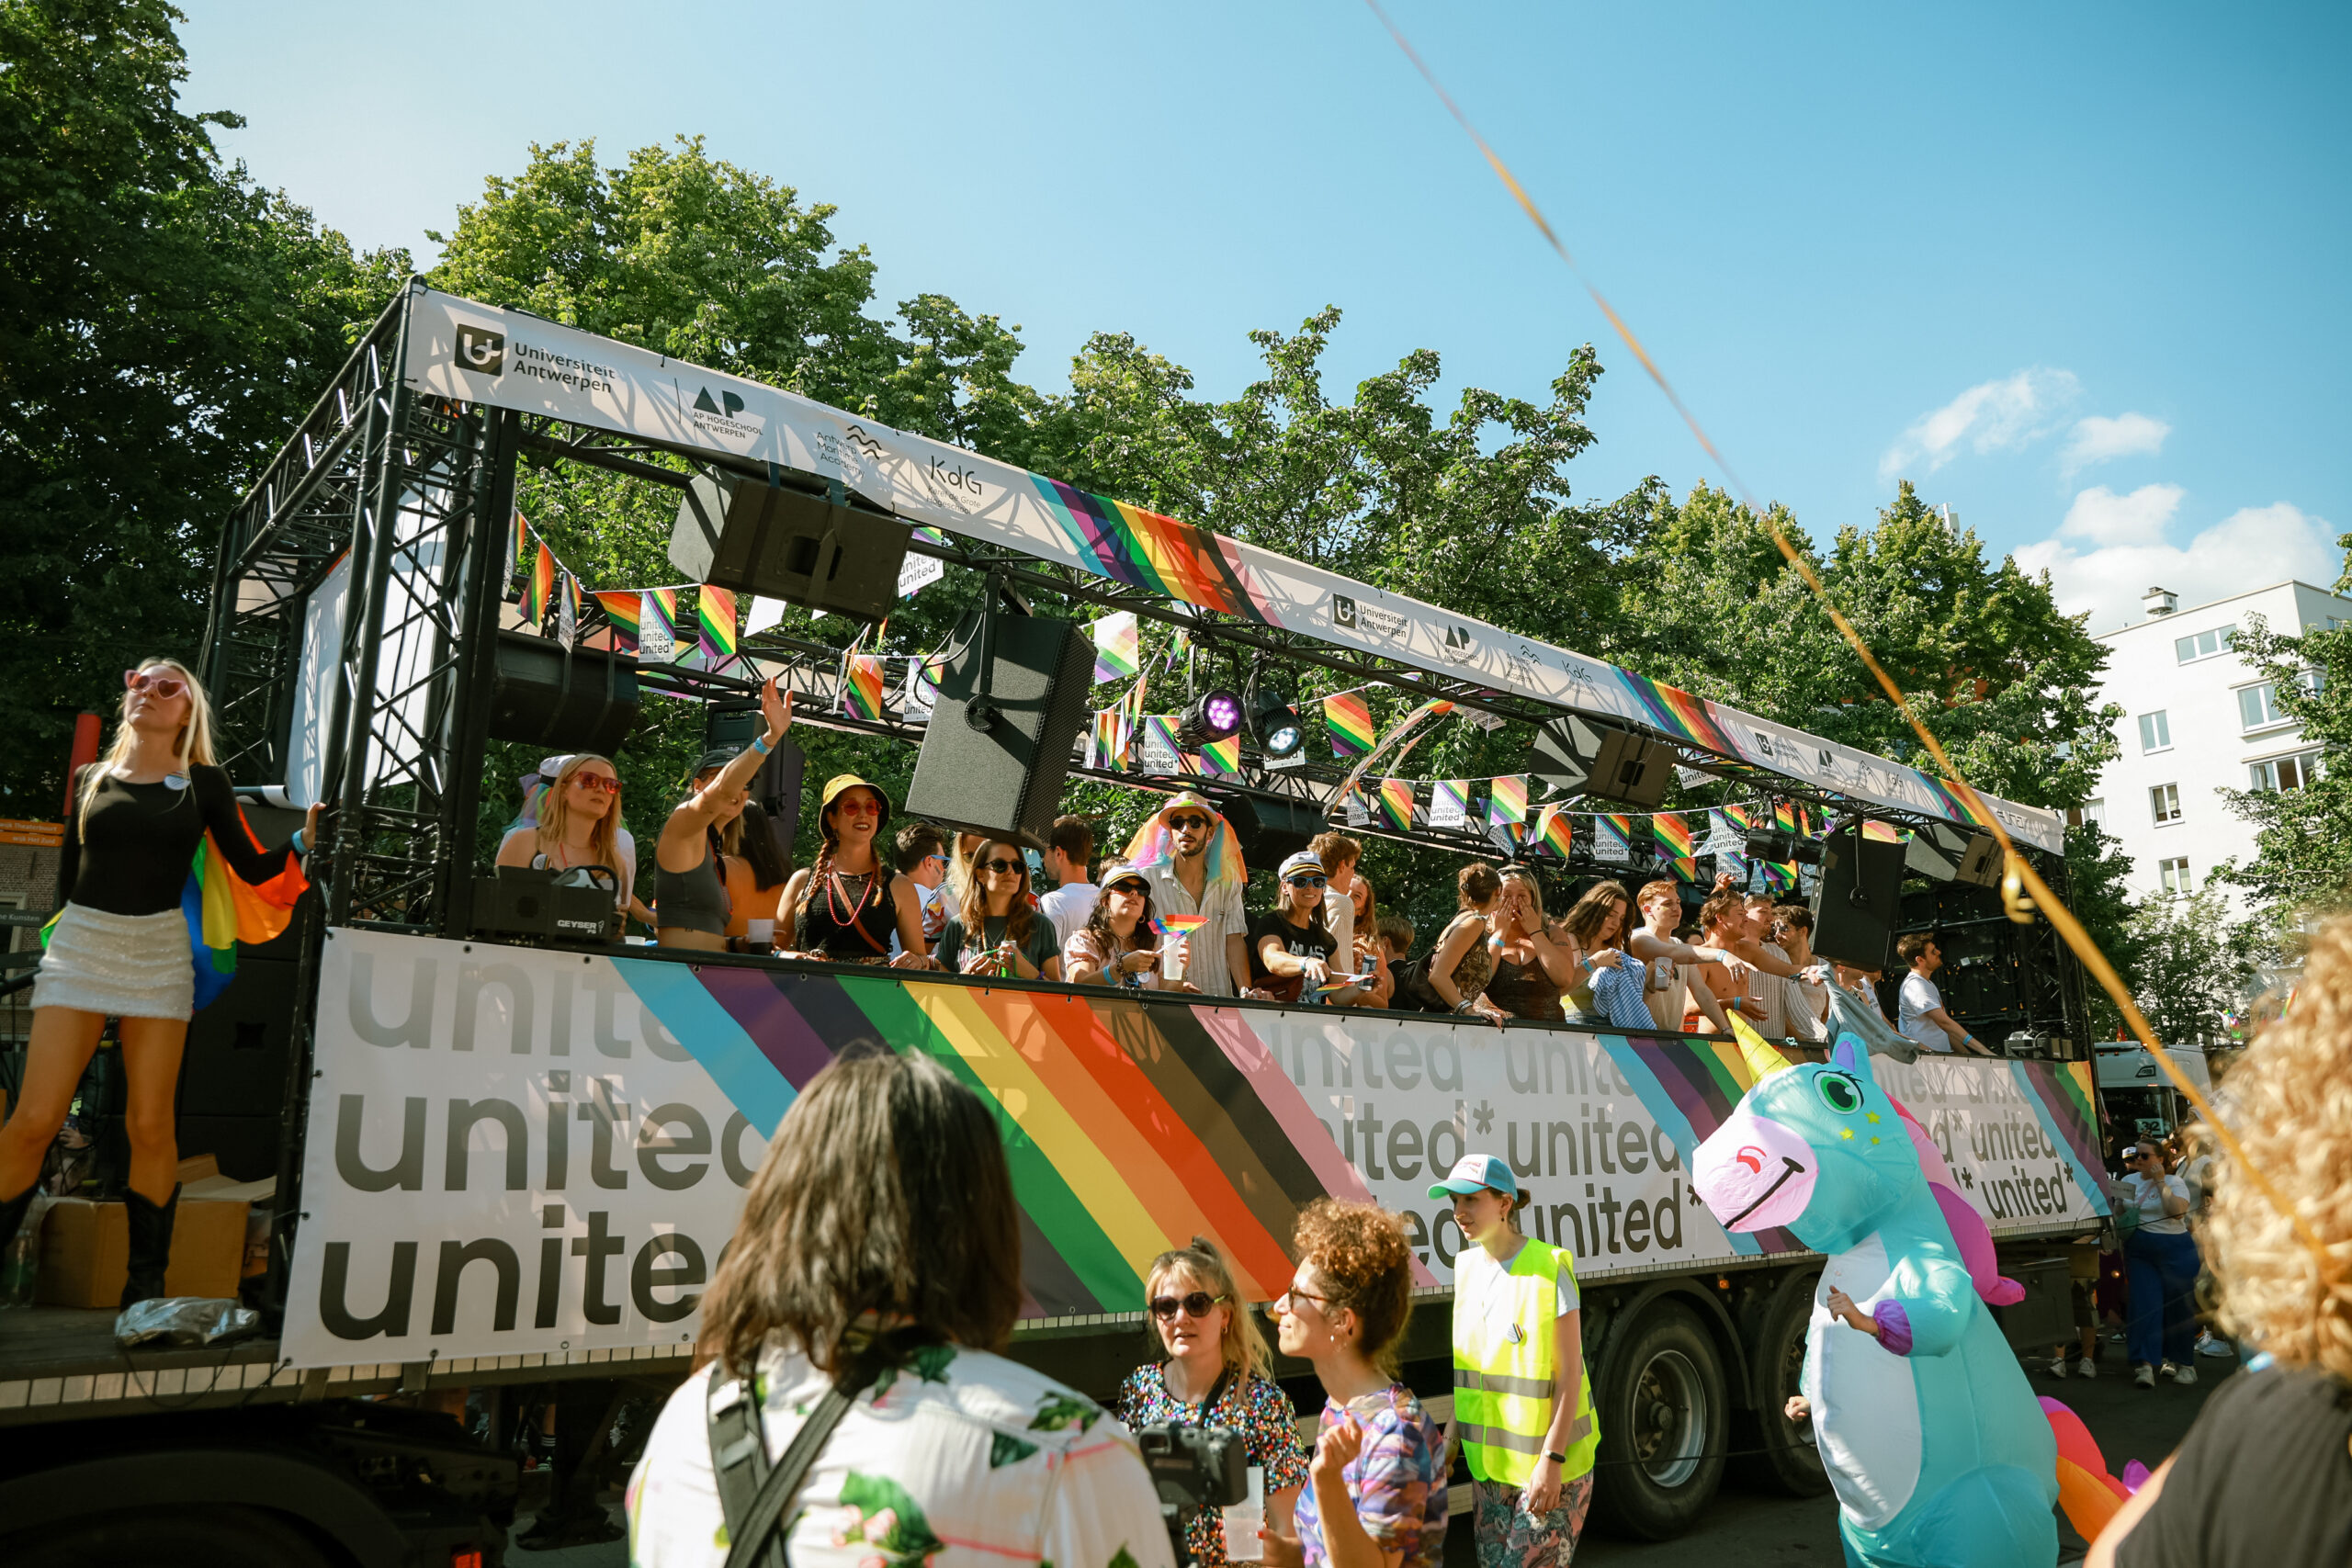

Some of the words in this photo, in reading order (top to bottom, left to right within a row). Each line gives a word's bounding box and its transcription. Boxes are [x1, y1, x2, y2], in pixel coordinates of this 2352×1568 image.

[515, 343, 615, 378] Universiteit
[514, 360, 612, 393] Antwerpen
[694, 412, 705, 420] AP
[707, 415, 763, 435] HOGESCHOOL
[694, 421, 745, 439] ANTWERPEN
[931, 455, 981, 495] KdG
[1360, 604, 1408, 626] Universiteit
[1361, 617, 1407, 637] Antwerpen
[1561, 660, 1594, 684] KdG
[1680, 770, 1706, 783] unite
[319, 1203, 732, 1341] unite
